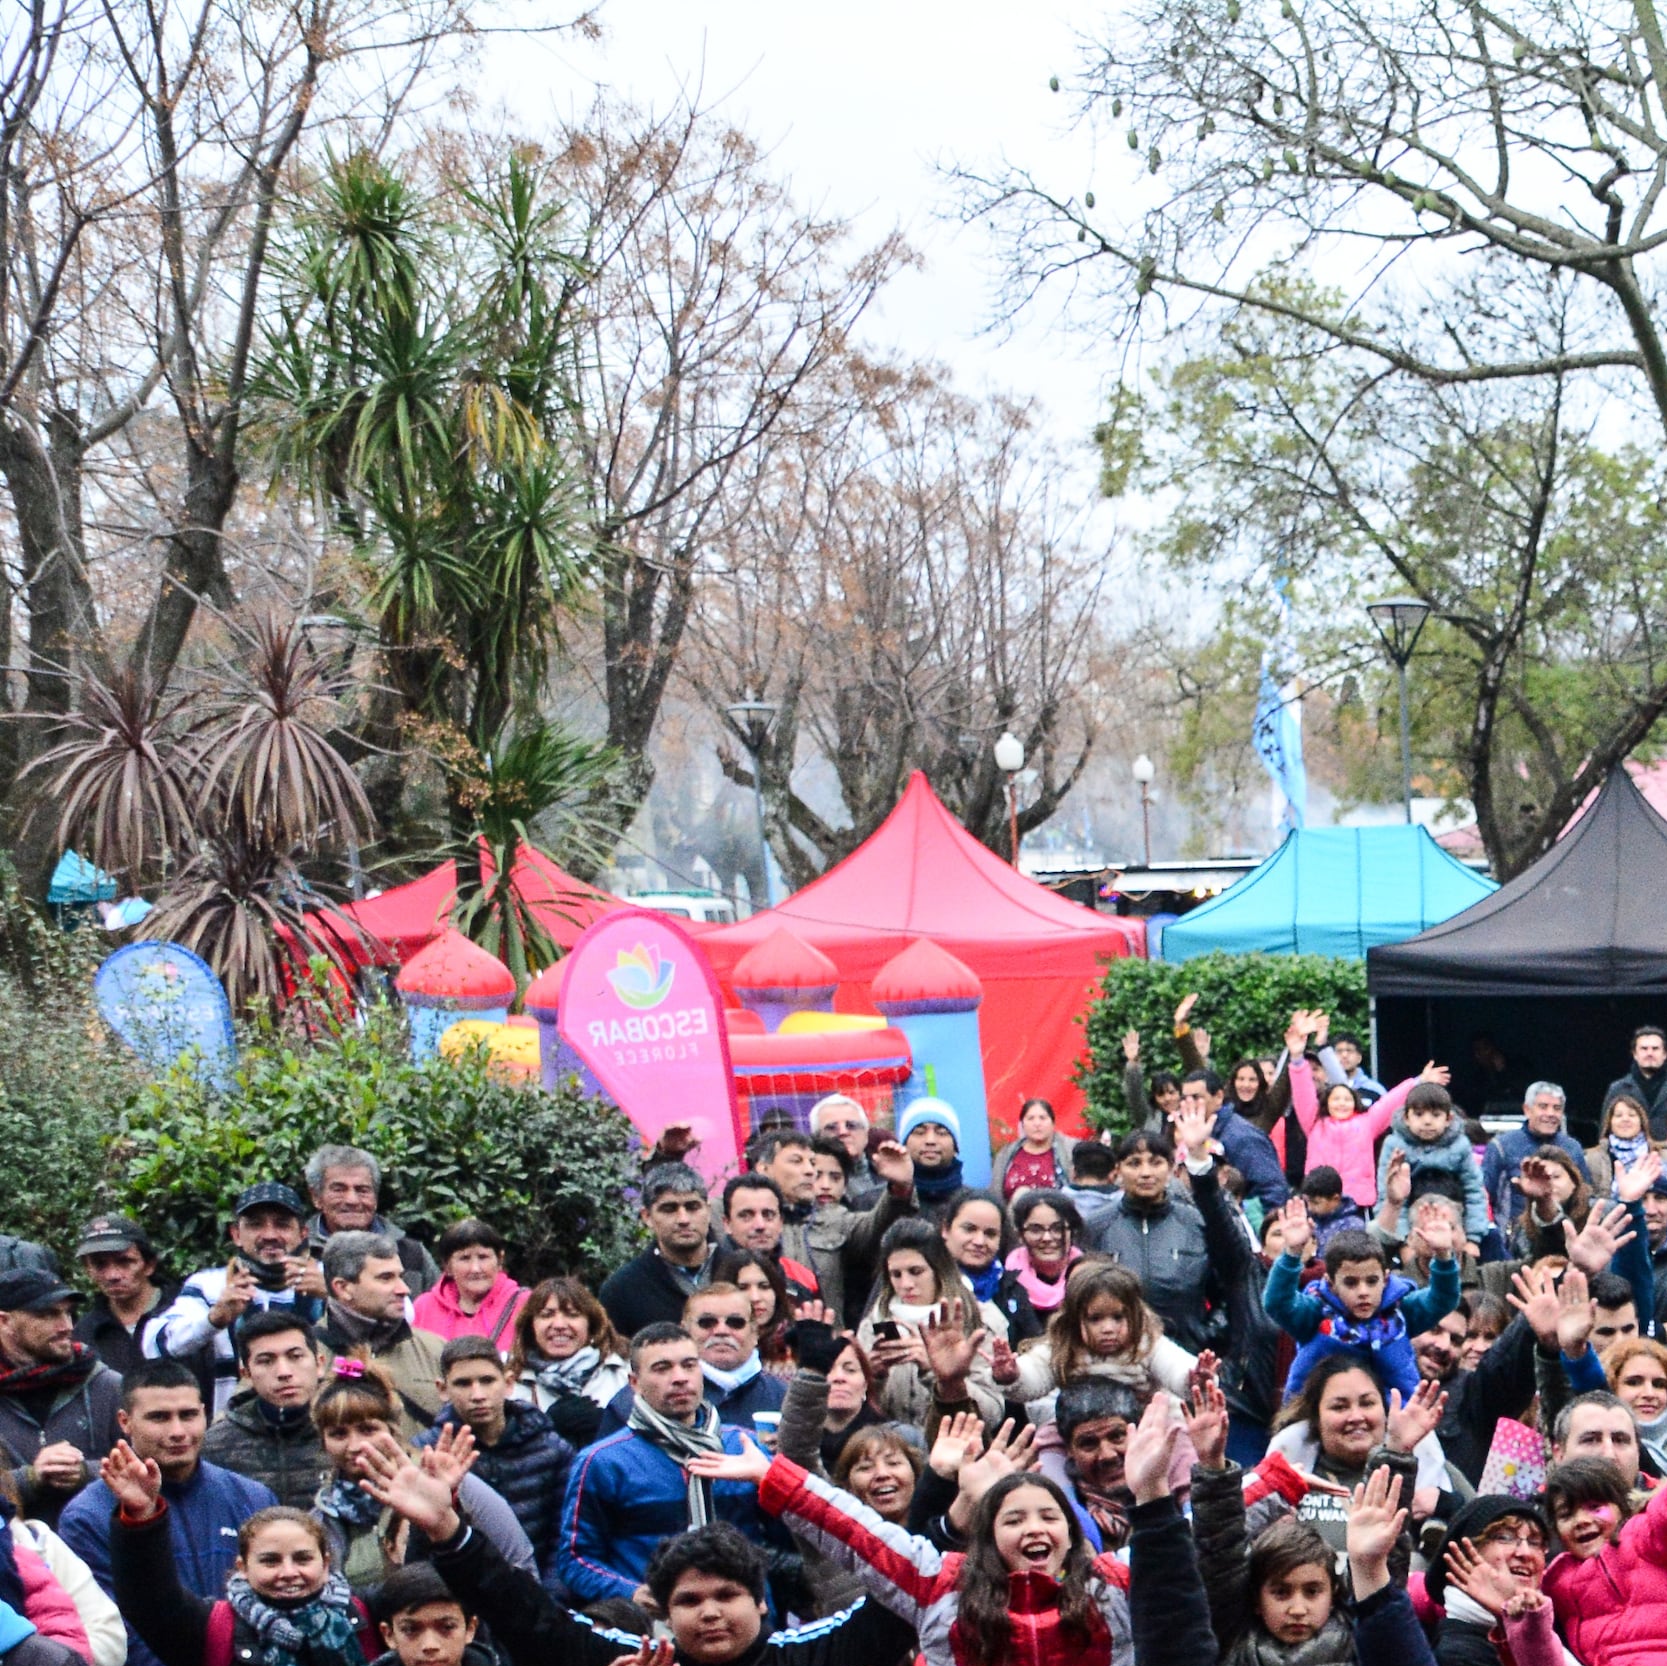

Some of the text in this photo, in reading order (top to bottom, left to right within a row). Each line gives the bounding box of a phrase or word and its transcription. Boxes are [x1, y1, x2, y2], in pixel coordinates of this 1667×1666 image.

[1299, 1493, 1332, 1508] ONT
[1297, 1507, 1350, 1522] OU WAN
